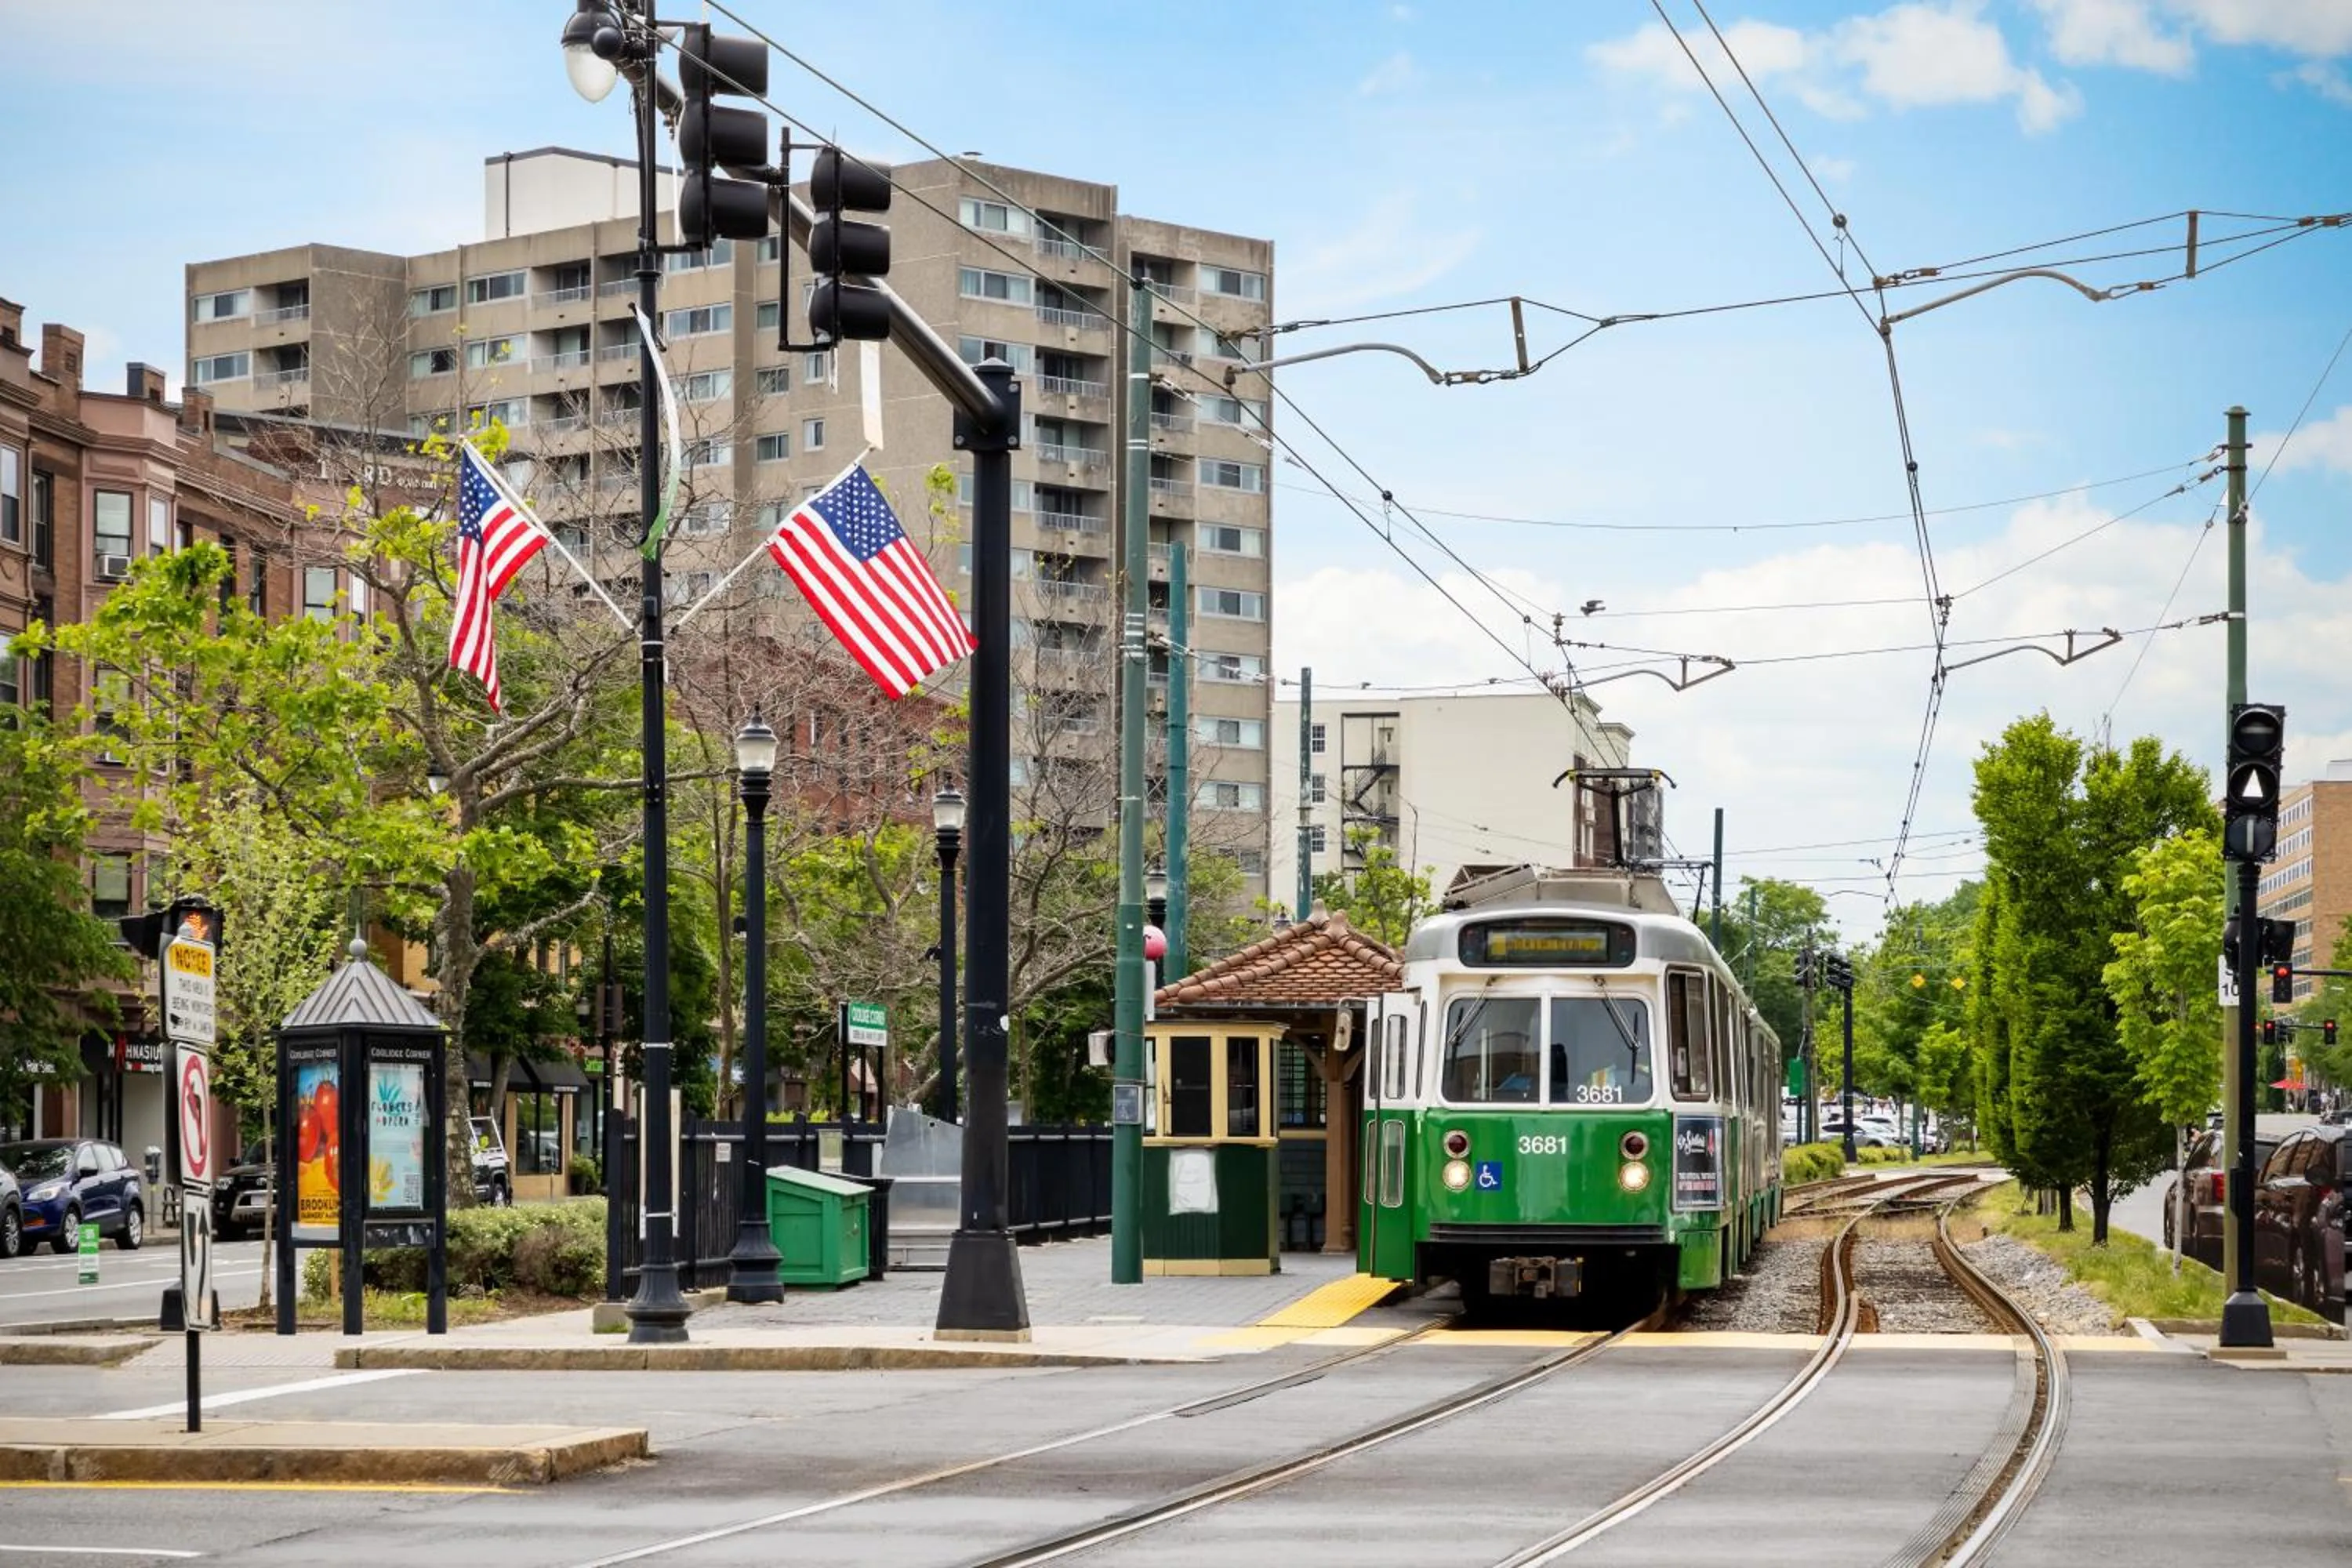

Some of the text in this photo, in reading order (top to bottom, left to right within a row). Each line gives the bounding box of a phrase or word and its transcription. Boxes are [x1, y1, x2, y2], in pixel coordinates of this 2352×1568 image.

[174, 946, 208, 973] NOTICE
[2222, 982, 2240, 996] 10
[315, 1047, 337, 1058] CORNER
[371, 1047, 431, 1058] COOLIDGE CORNER
[1577, 1084, 1622, 1103] 3681
[1518, 1135, 1566, 1155] 3681
